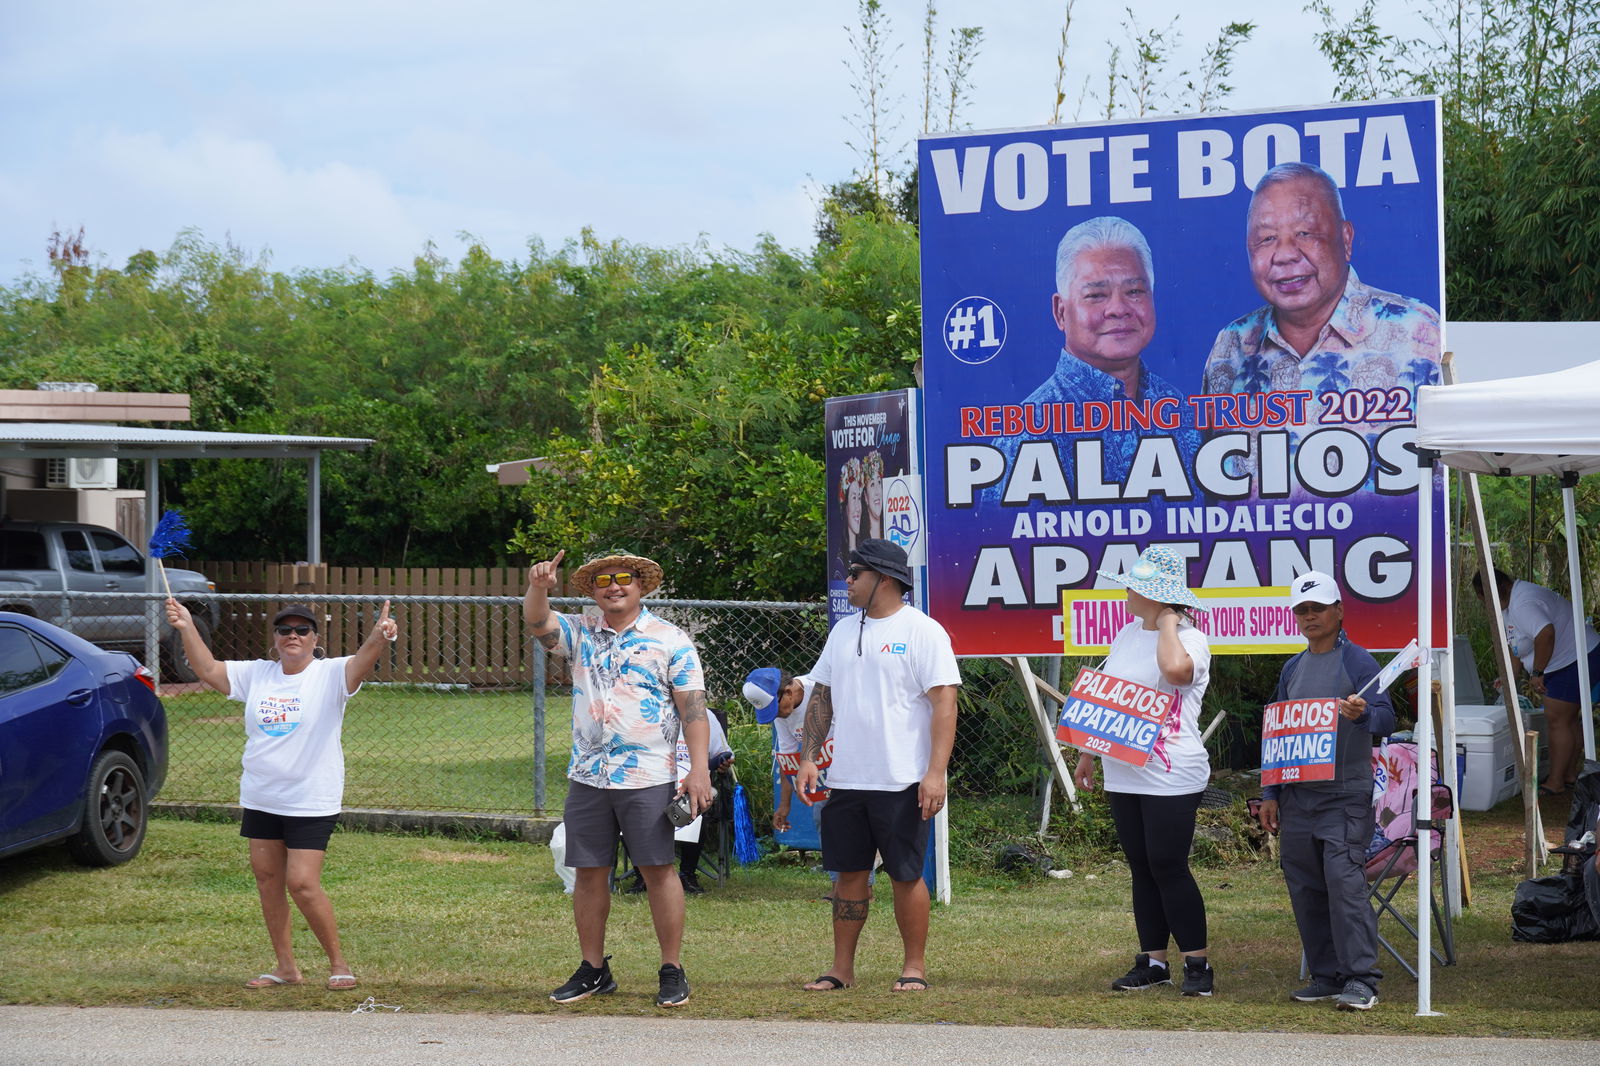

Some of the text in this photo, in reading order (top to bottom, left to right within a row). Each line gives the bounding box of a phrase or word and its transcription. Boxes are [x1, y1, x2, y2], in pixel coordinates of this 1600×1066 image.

[930, 114, 1420, 216] VOTE BOTA
[947, 304, 1001, 351] #1
[844, 412, 887, 427] THIS NOVEMBER
[960, 387, 1412, 438] REBUILDING TRUST 2022
[832, 427, 855, 449] VOTE
[855, 426, 875, 448] FOR
[944, 424, 1419, 509] PALACIOS
[888, 496, 910, 513] 2022
[1011, 502, 1353, 540] ARNOLD INDALECIO
[1211, 606, 1246, 637] YOUR
[1249, 606, 1301, 637] SUPPOR
[1073, 670, 1169, 717] PALACIOS
[1062, 700, 1157, 746] APATANG
[1264, 701, 1336, 733] PALACIOS
[1084, 736, 1112, 753] 2022
[1263, 733, 1333, 764] APATANG
[1281, 767, 1300, 780] 2022
